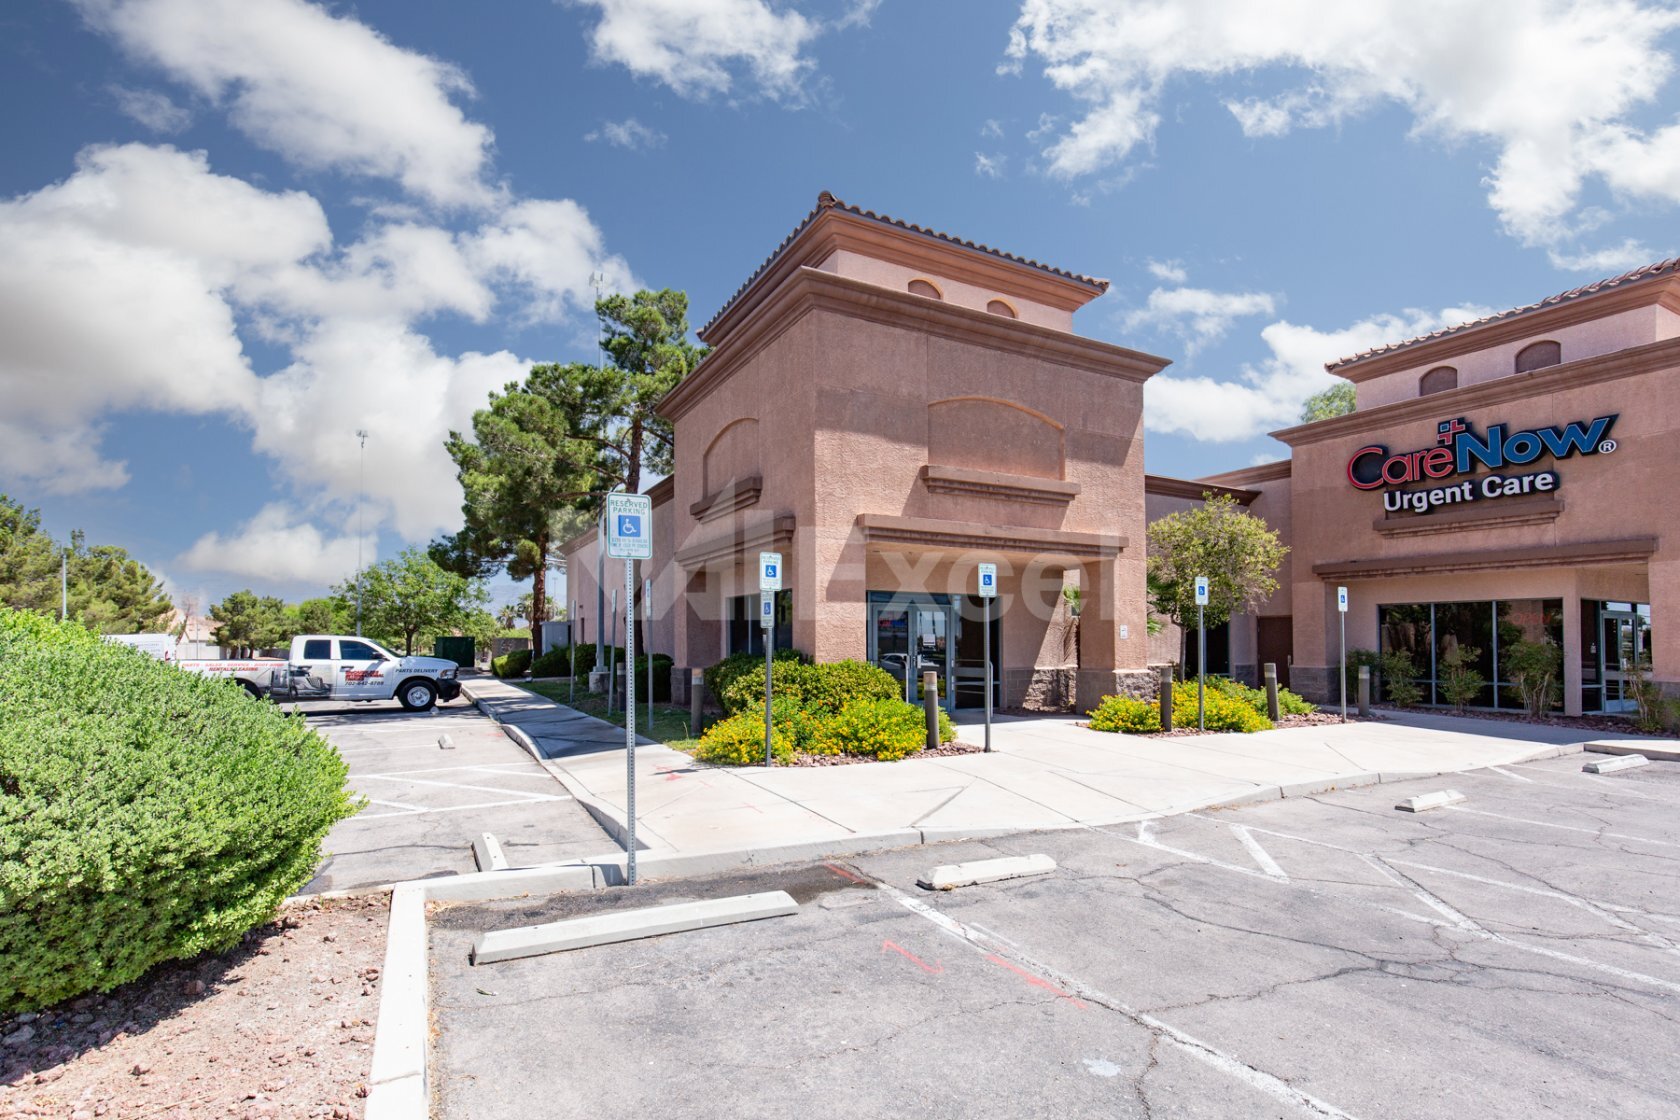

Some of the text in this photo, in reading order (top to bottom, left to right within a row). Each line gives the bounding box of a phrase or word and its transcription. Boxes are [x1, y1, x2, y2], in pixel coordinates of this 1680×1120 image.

[1384, 472, 1554, 514] Urgent Care
[610, 499, 648, 509] RESERVED
[612, 507, 646, 515] PARKING
